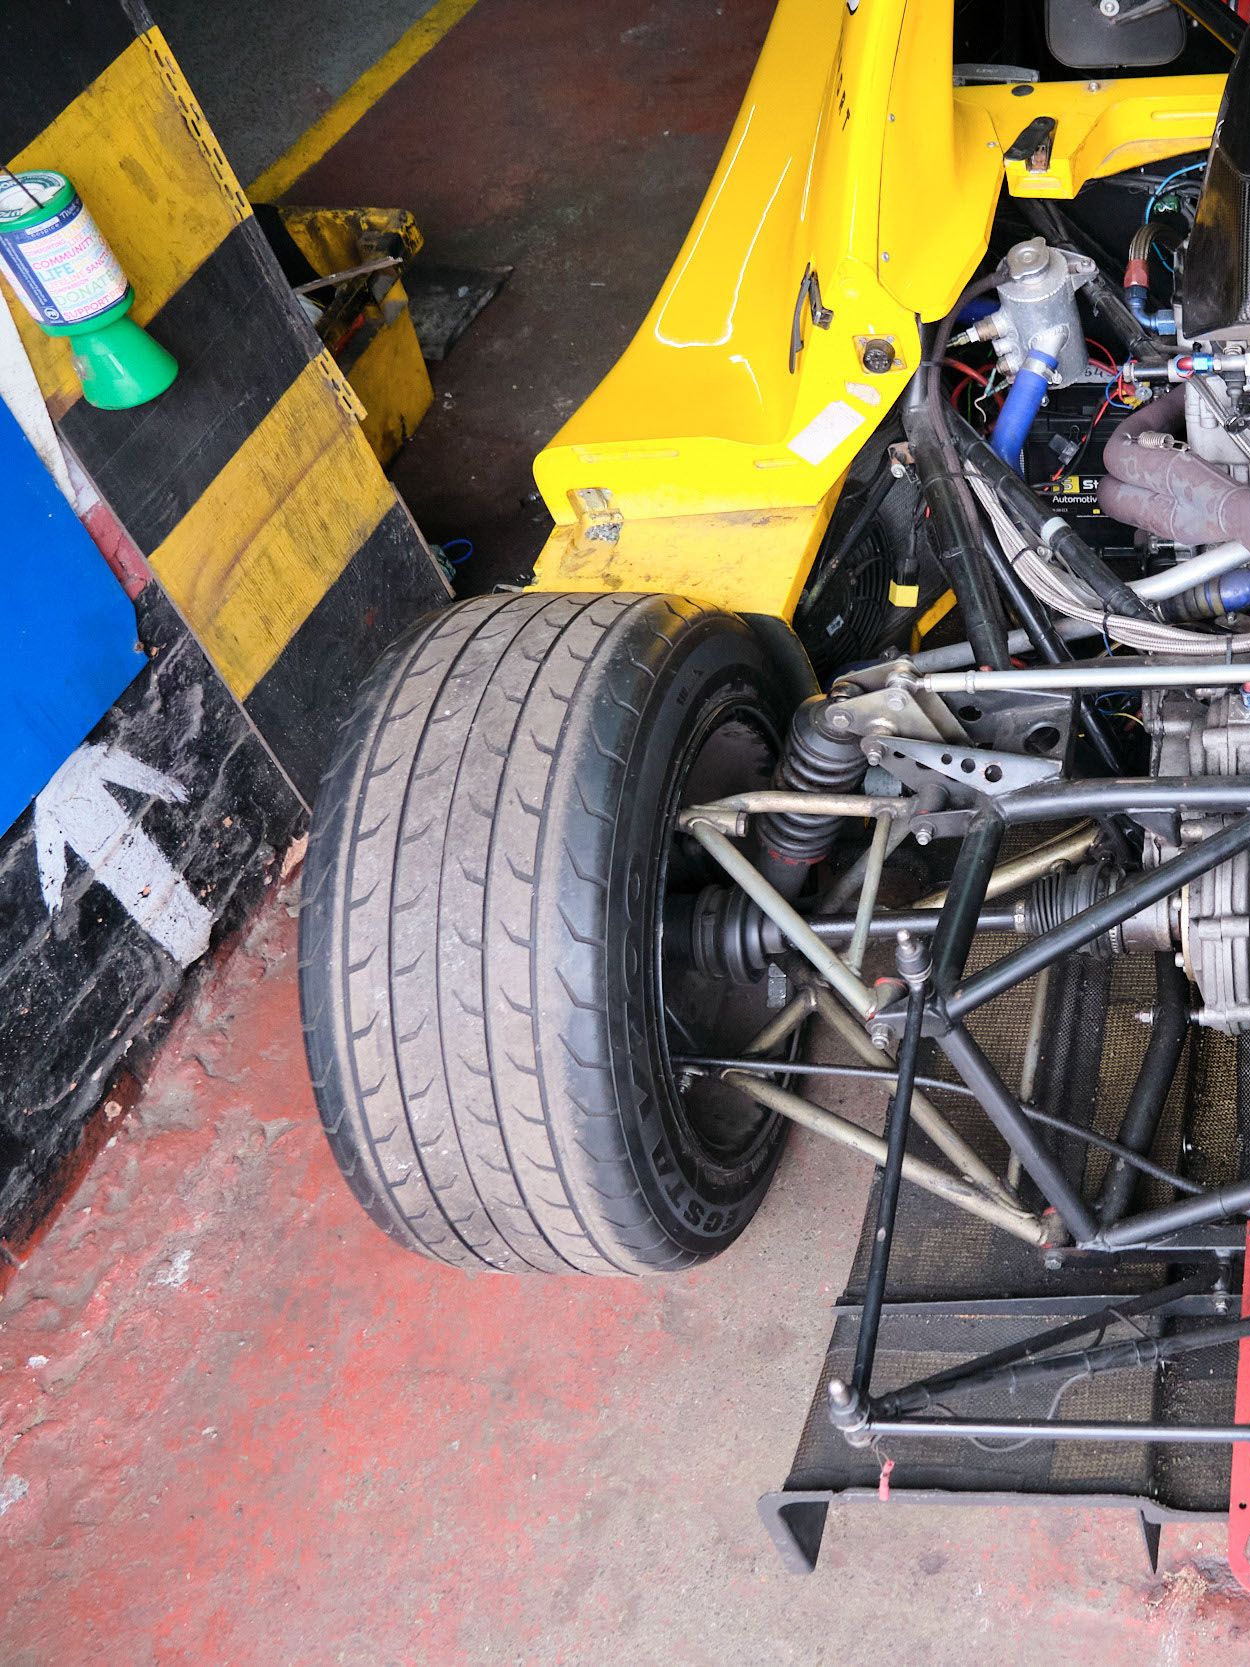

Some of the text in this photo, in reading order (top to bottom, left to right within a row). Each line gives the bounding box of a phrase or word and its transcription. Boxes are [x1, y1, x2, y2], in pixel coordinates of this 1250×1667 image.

[32, 234, 94, 270] COMMUNITY
[37, 262, 75, 282] LIFE
[54, 269, 115, 305] DONATE
[63, 294, 110, 319] SUPPORT
[1082, 479, 1100, 490] St
[1052, 495, 1098, 504] Automotiv
[651, 1136, 737, 1233] ECSTA
